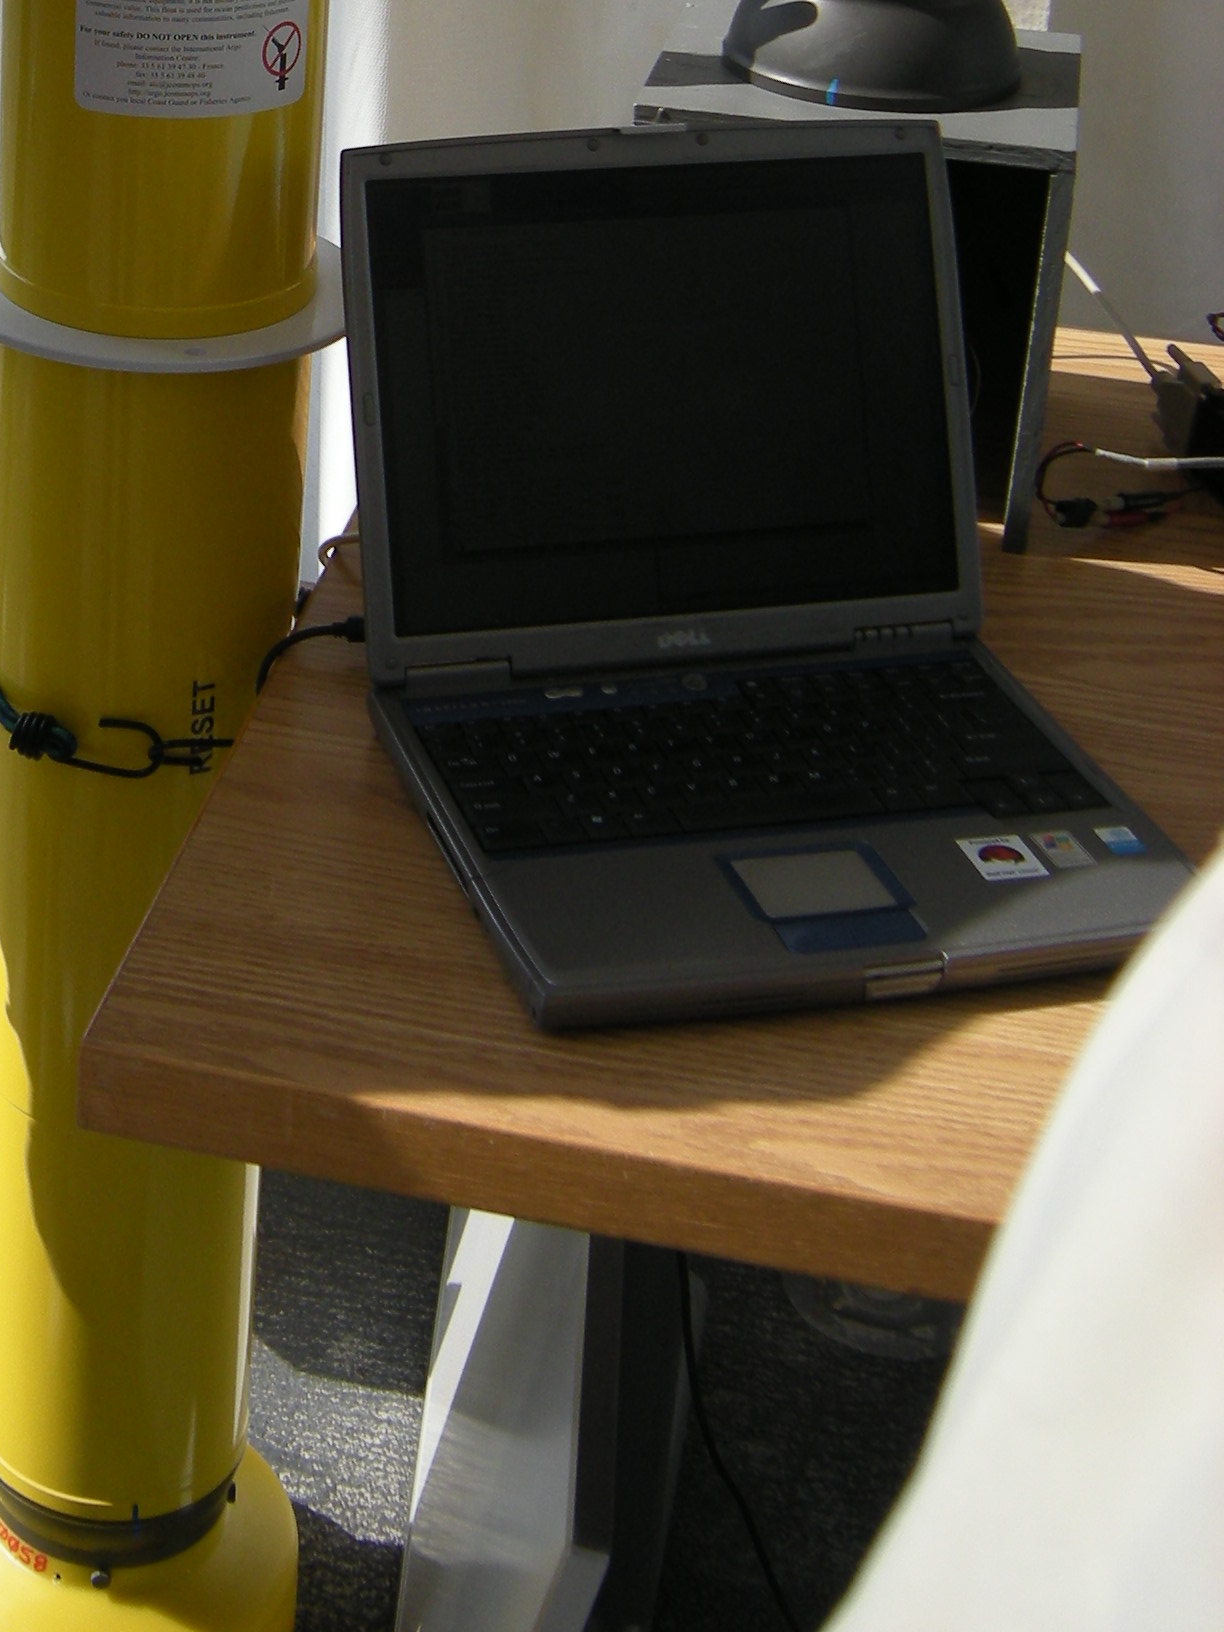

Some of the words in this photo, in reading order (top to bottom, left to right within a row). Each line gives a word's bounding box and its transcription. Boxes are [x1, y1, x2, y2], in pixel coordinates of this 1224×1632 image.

[79, 24, 92, 33] For
[94, 28, 110, 37] your
[112, 30, 134, 42] safety
[136, 32, 150, 40] DO
[152, 33, 171, 41] NOT
[173, 33, 199, 41] OPEN
[200, 33, 215, 41] this
[657, 628, 711, 649] DELL
